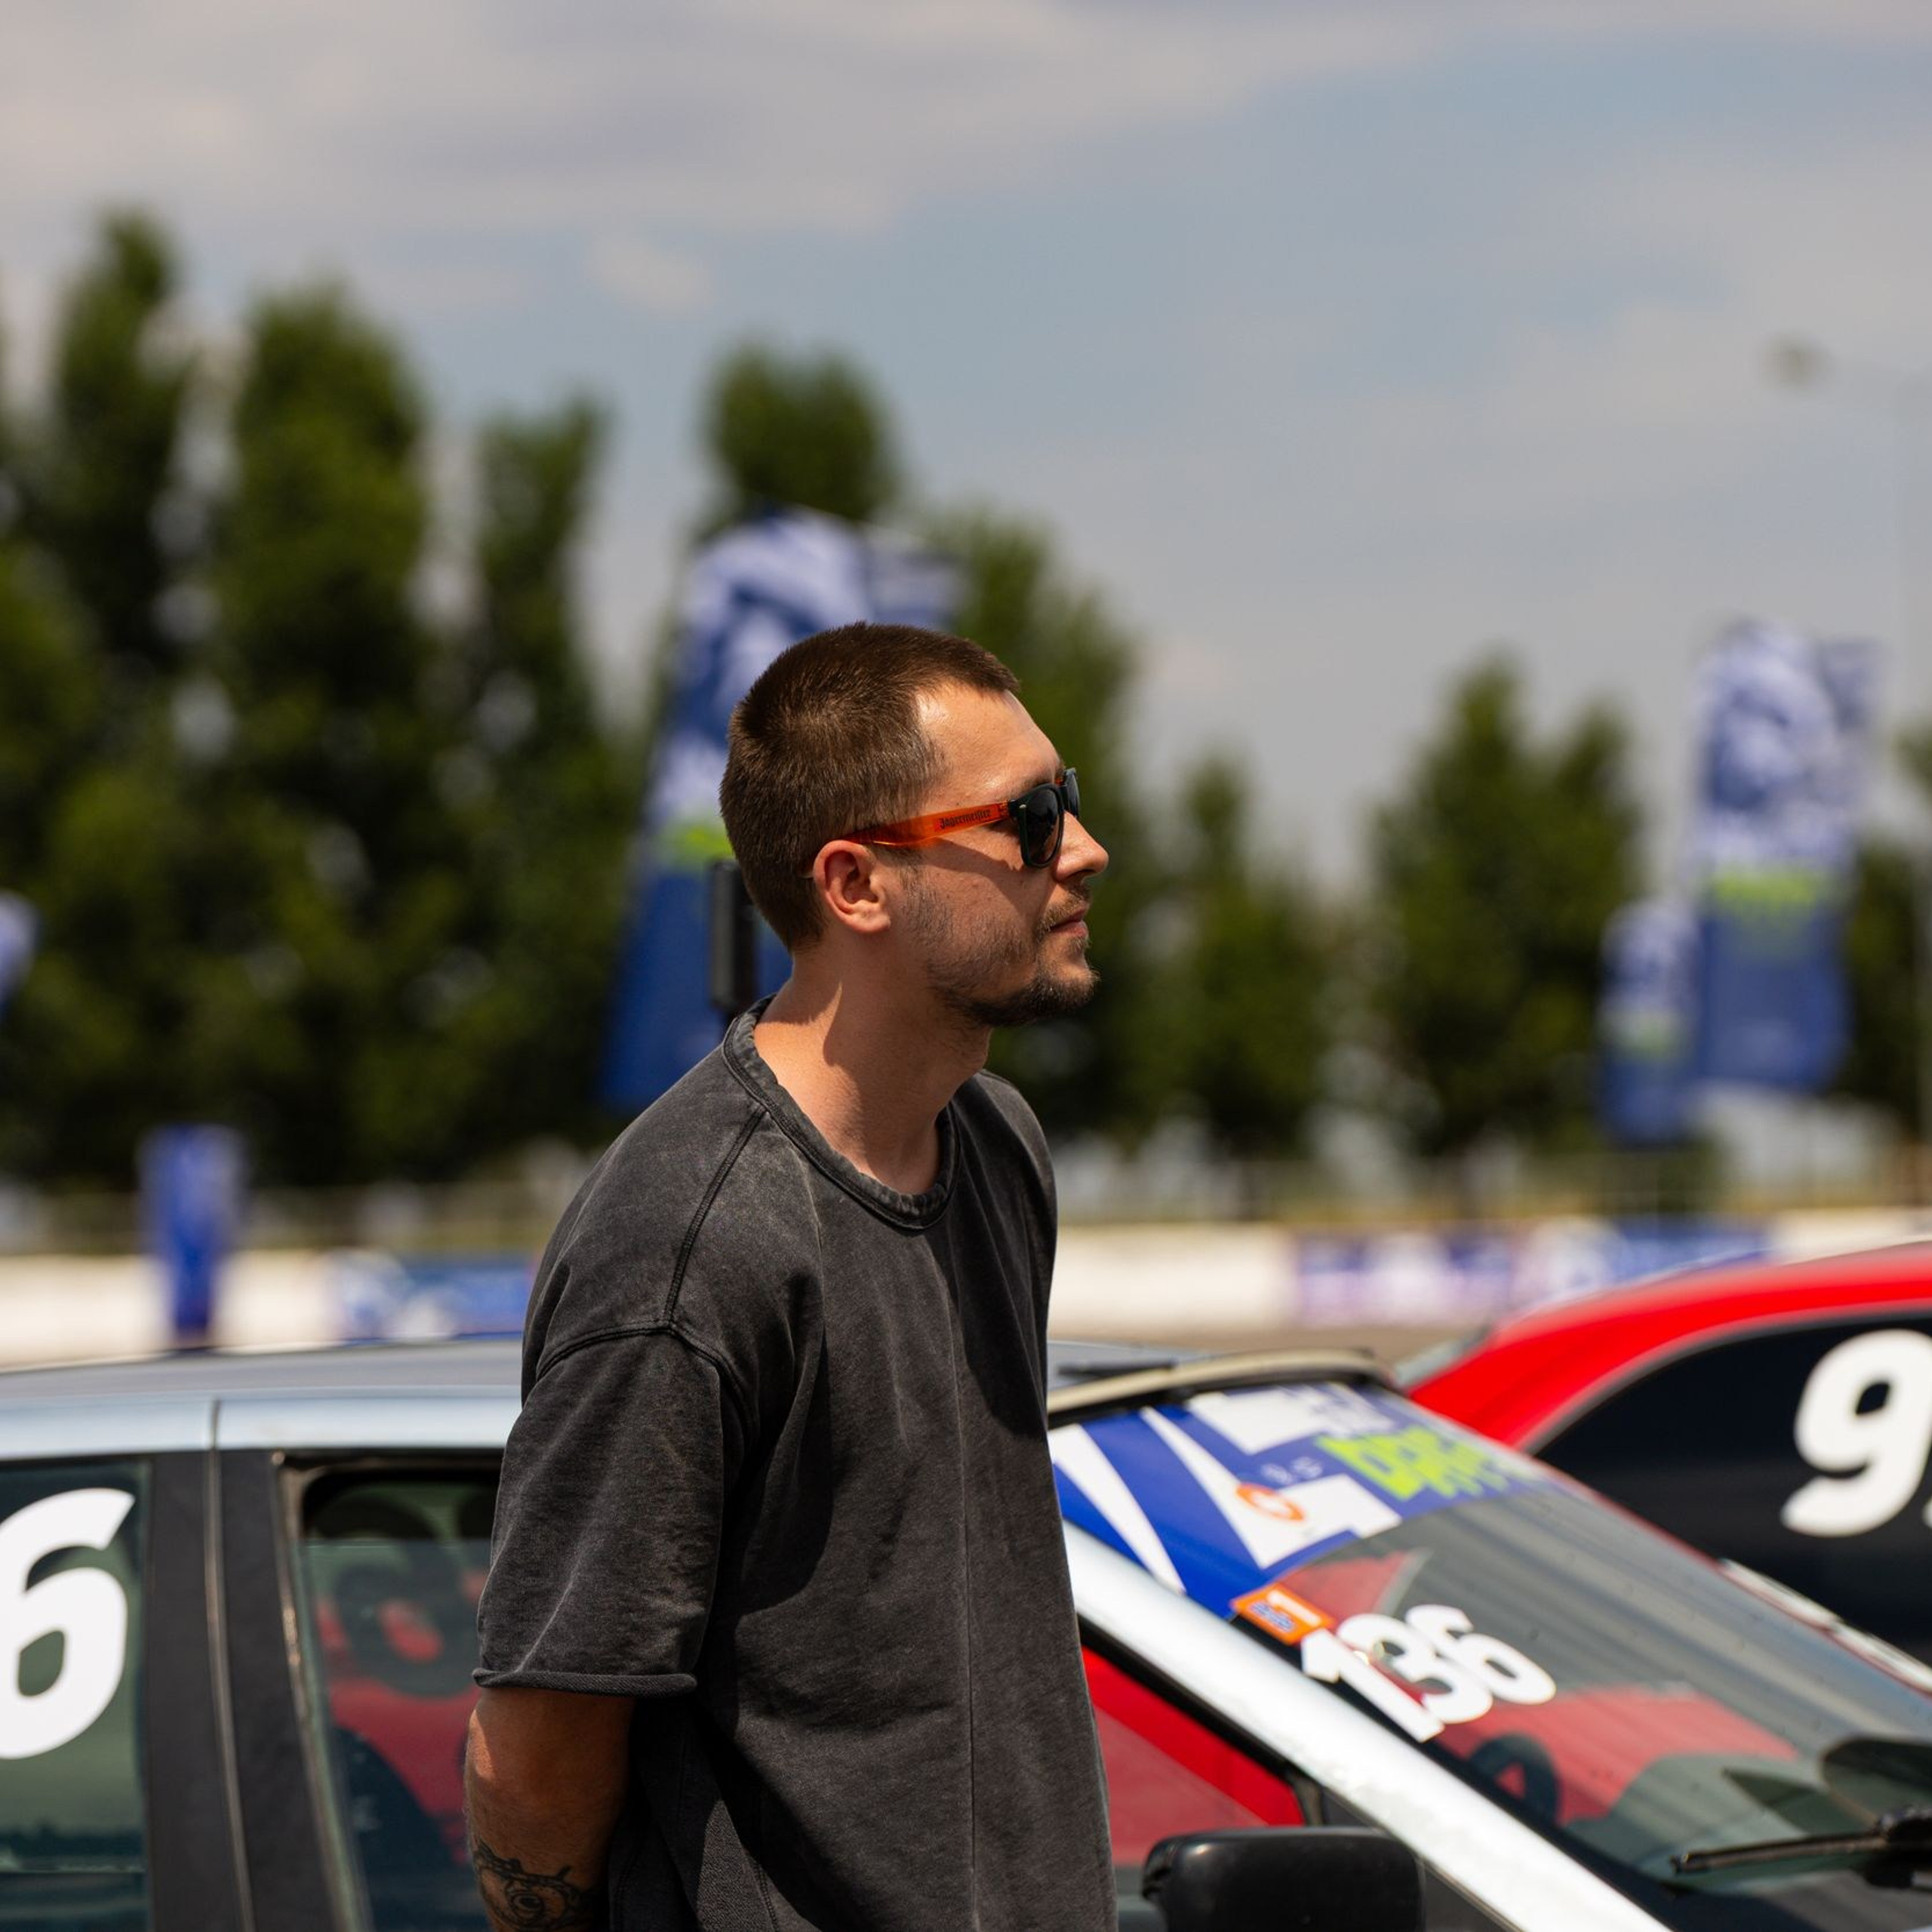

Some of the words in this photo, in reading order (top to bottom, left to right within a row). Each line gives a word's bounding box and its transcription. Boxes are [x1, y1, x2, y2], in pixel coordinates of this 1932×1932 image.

[1780, 1328, 1932, 1537] 9
[0, 1487, 135, 1759] 6
[1301, 1604, 1556, 1743] 136
